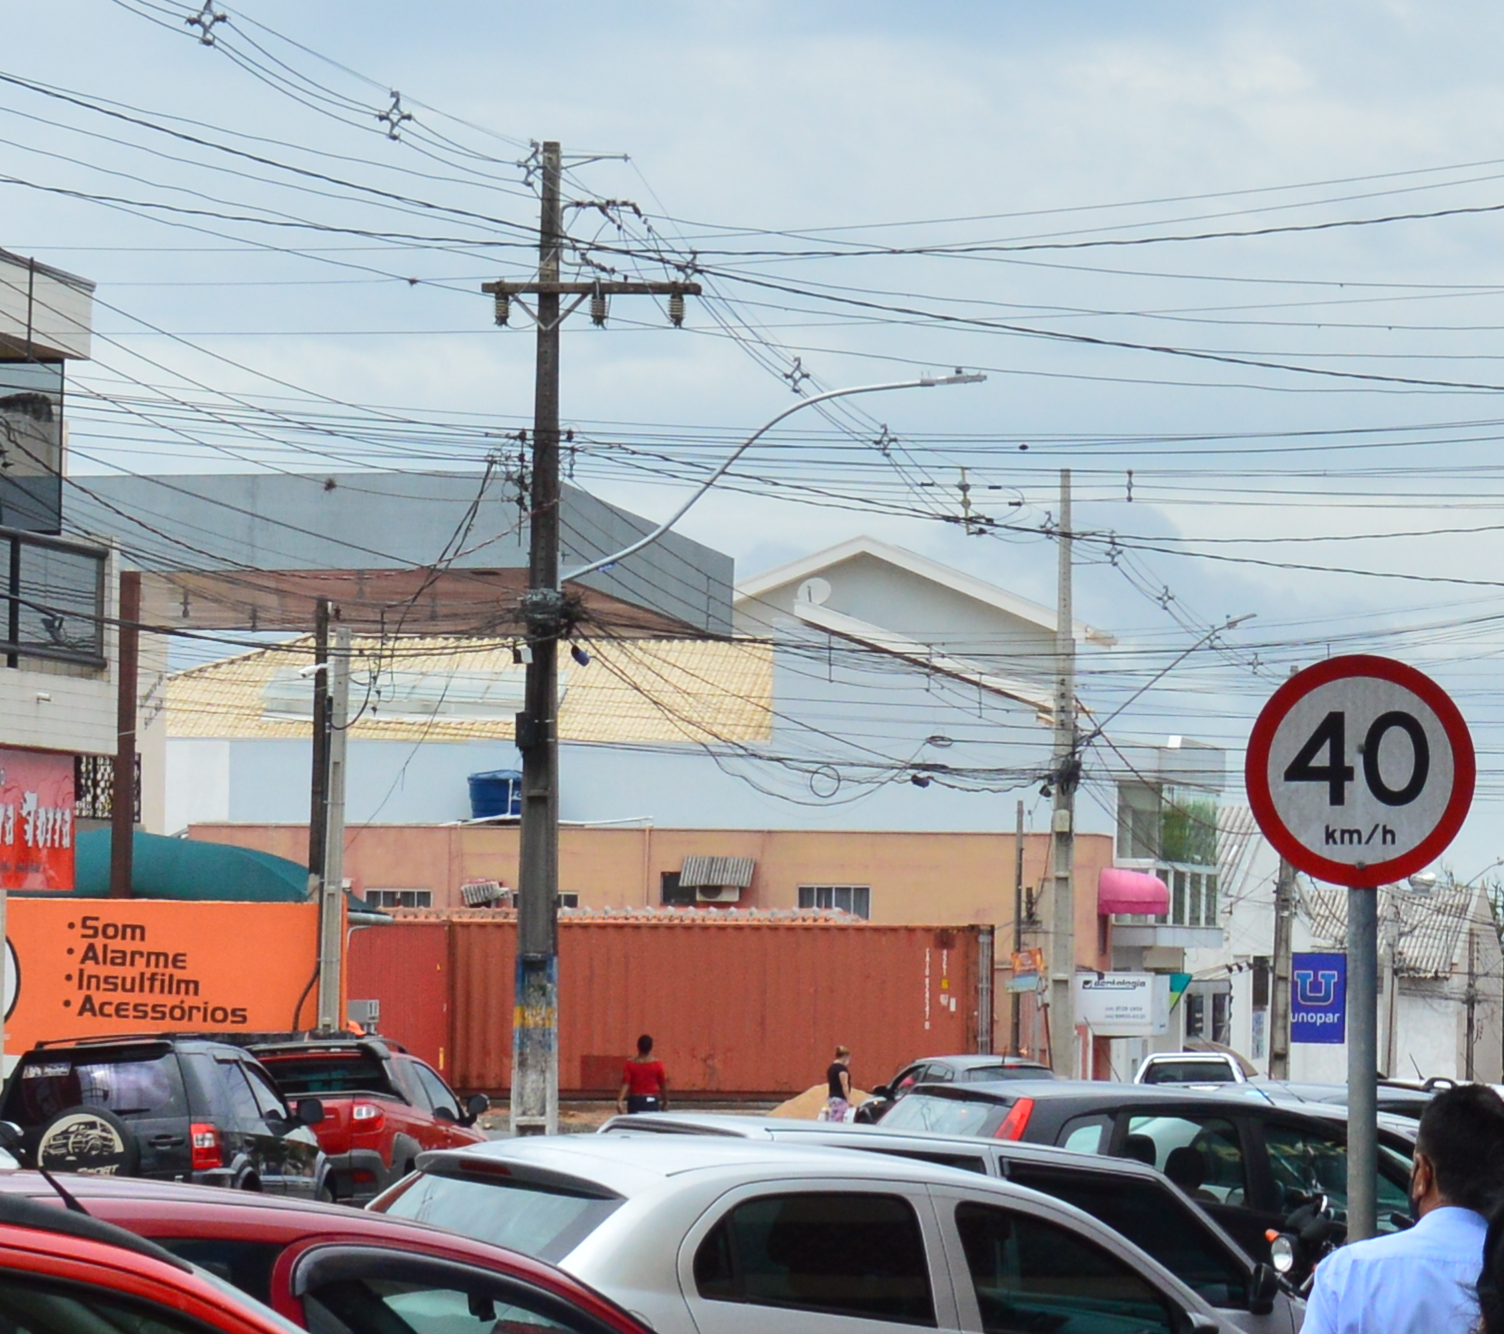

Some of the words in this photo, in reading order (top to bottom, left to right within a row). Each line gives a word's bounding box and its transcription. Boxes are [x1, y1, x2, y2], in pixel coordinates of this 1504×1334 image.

[1284, 710, 1430, 807] 40
[21, 790, 71, 849] Torra
[1325, 824, 1396, 846] km/h
[80, 916, 146, 942] Som
[79, 943, 188, 969] Alarme
[77, 969, 200, 997] Insulfilm
[76, 995, 248, 1025] Acessórios
[1290, 1011, 1341, 1026] unopar
